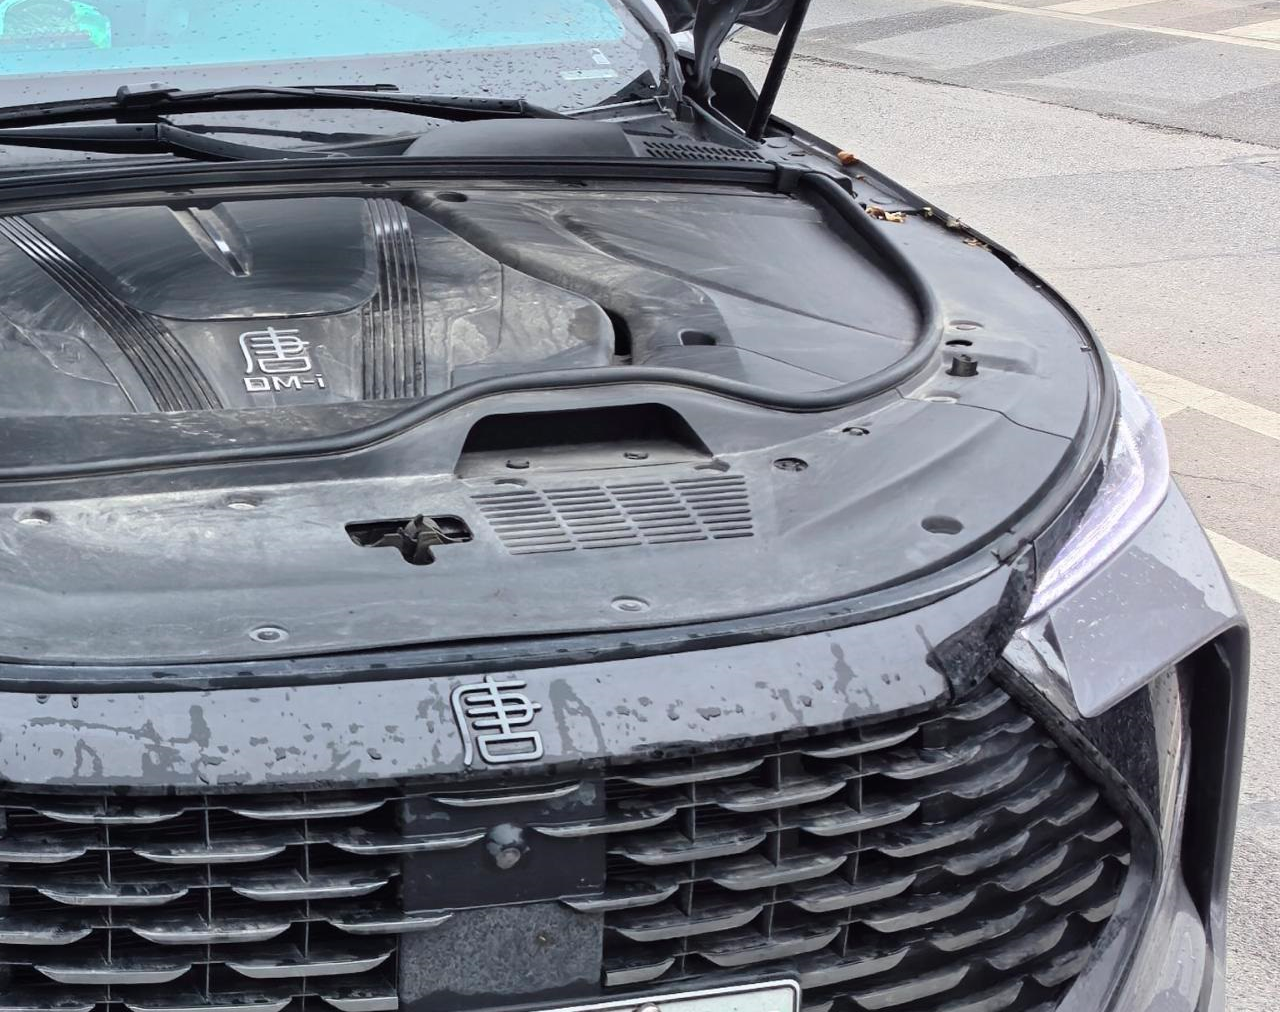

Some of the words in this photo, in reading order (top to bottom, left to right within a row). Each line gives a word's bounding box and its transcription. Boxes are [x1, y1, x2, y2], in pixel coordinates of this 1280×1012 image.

[239, 326, 312, 374] 唐
[243, 373, 326, 392] DM-i
[451, 674, 544, 766] 唐
